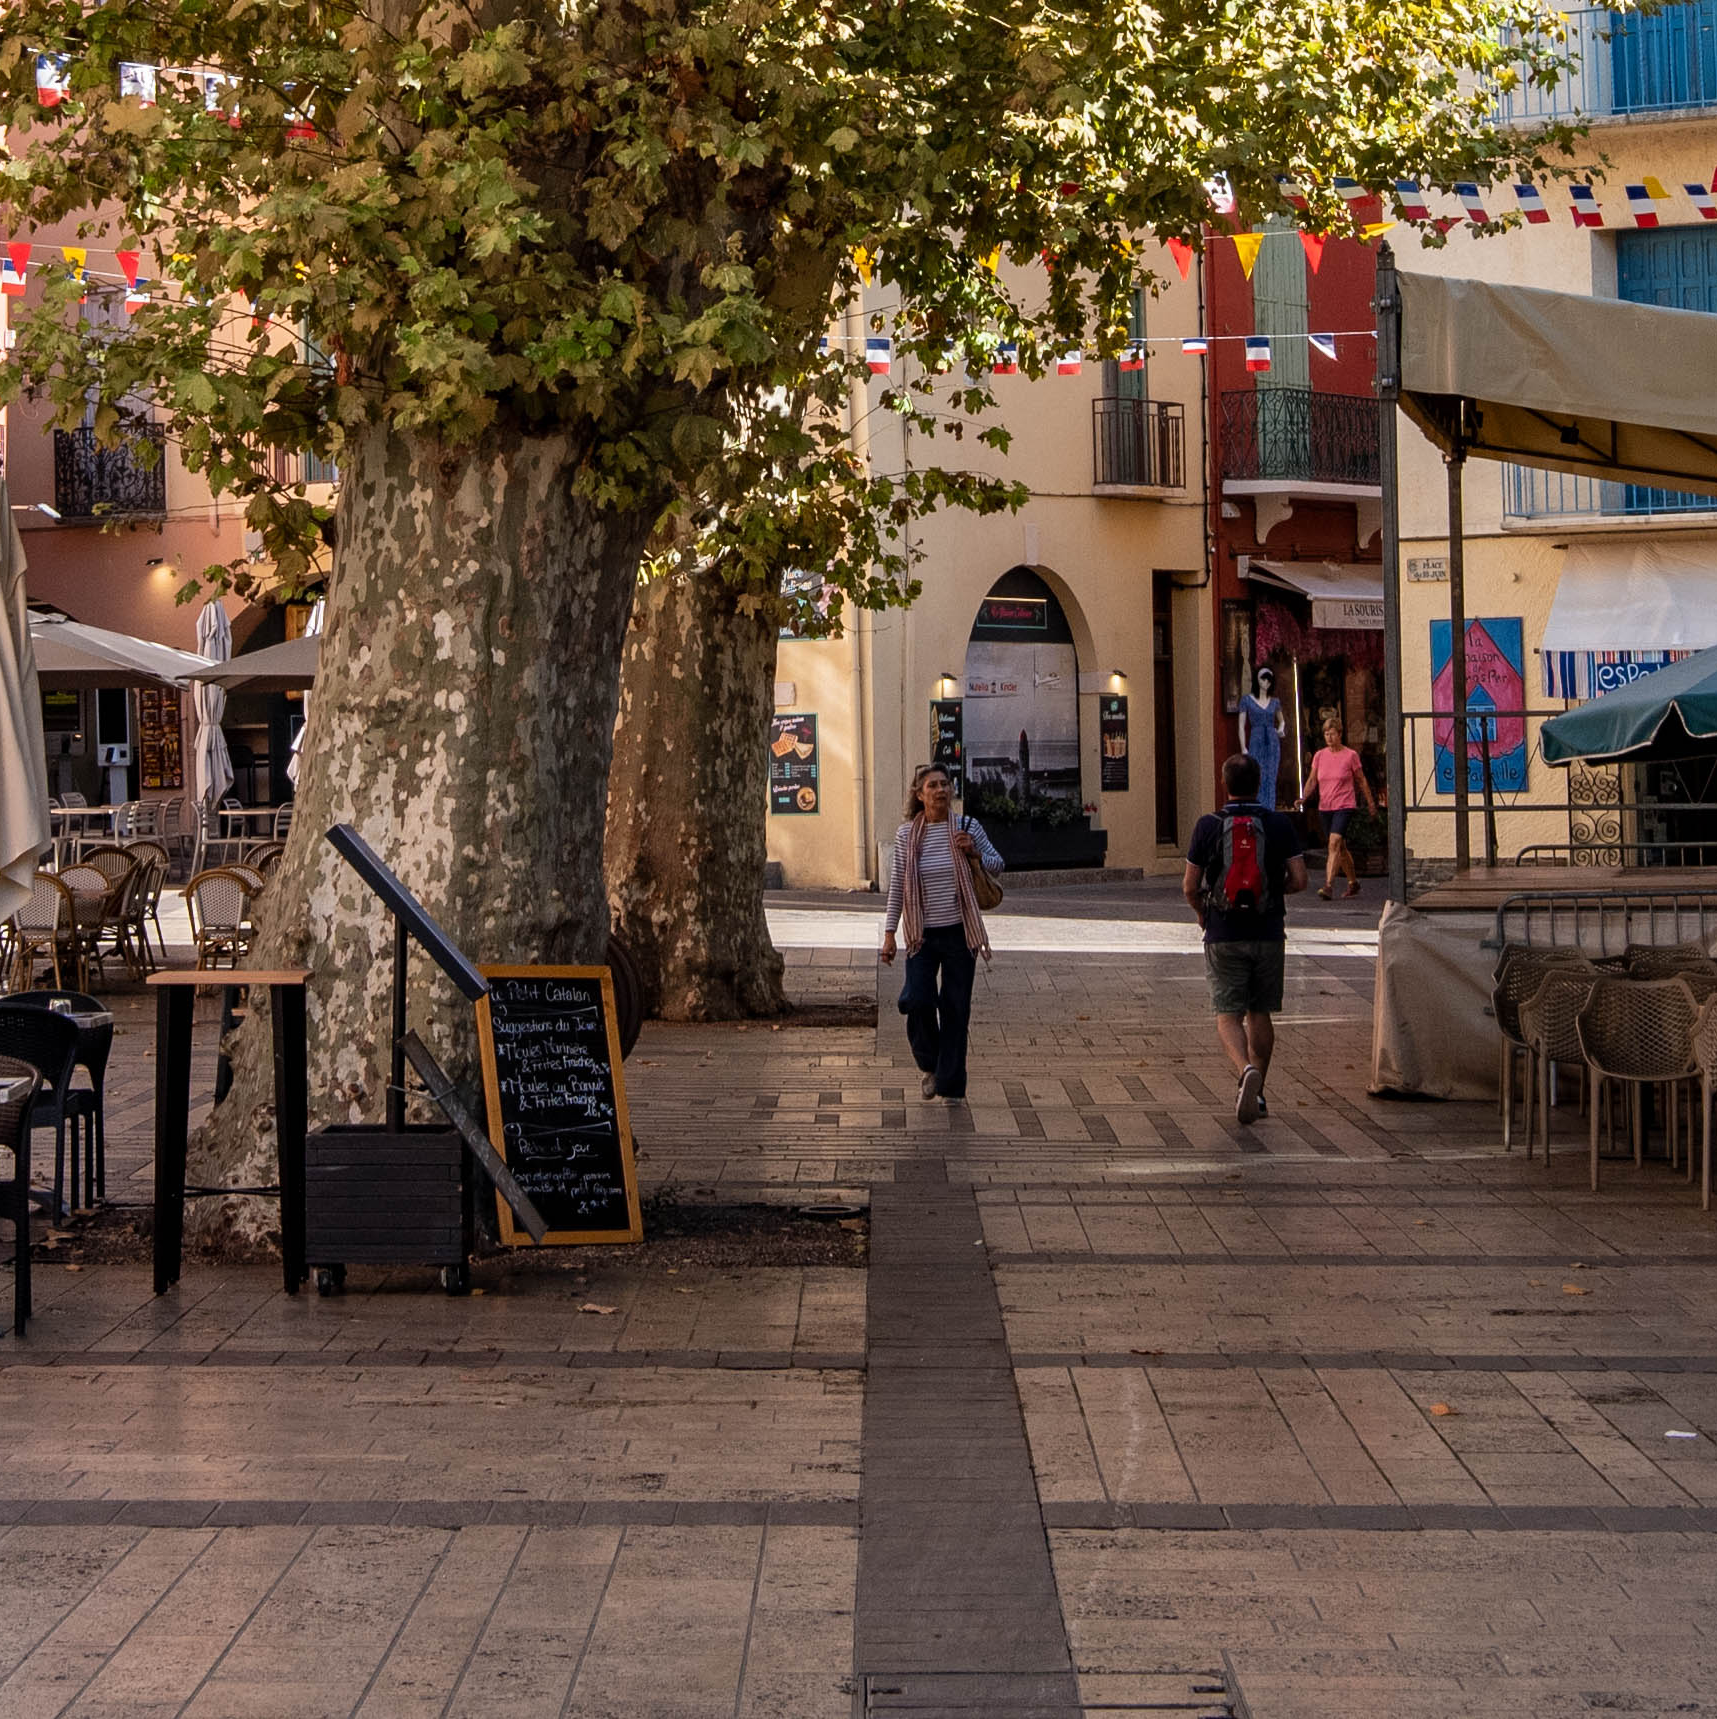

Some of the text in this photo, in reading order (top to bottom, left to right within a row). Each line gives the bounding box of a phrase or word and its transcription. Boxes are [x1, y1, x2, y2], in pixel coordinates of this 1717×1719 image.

[1423, 561, 1443, 569] PLACE
[1343, 603, 1384, 617] LA SOURIS
[1468, 631, 1483, 647] la
[507, 980, 540, 999] Petit
[545, 981, 591, 1002] Catalan
[492, 1016, 553, 1039] Suggestions
[555, 1018, 570, 1032] du
[507, 1075, 549, 1094] Moules
